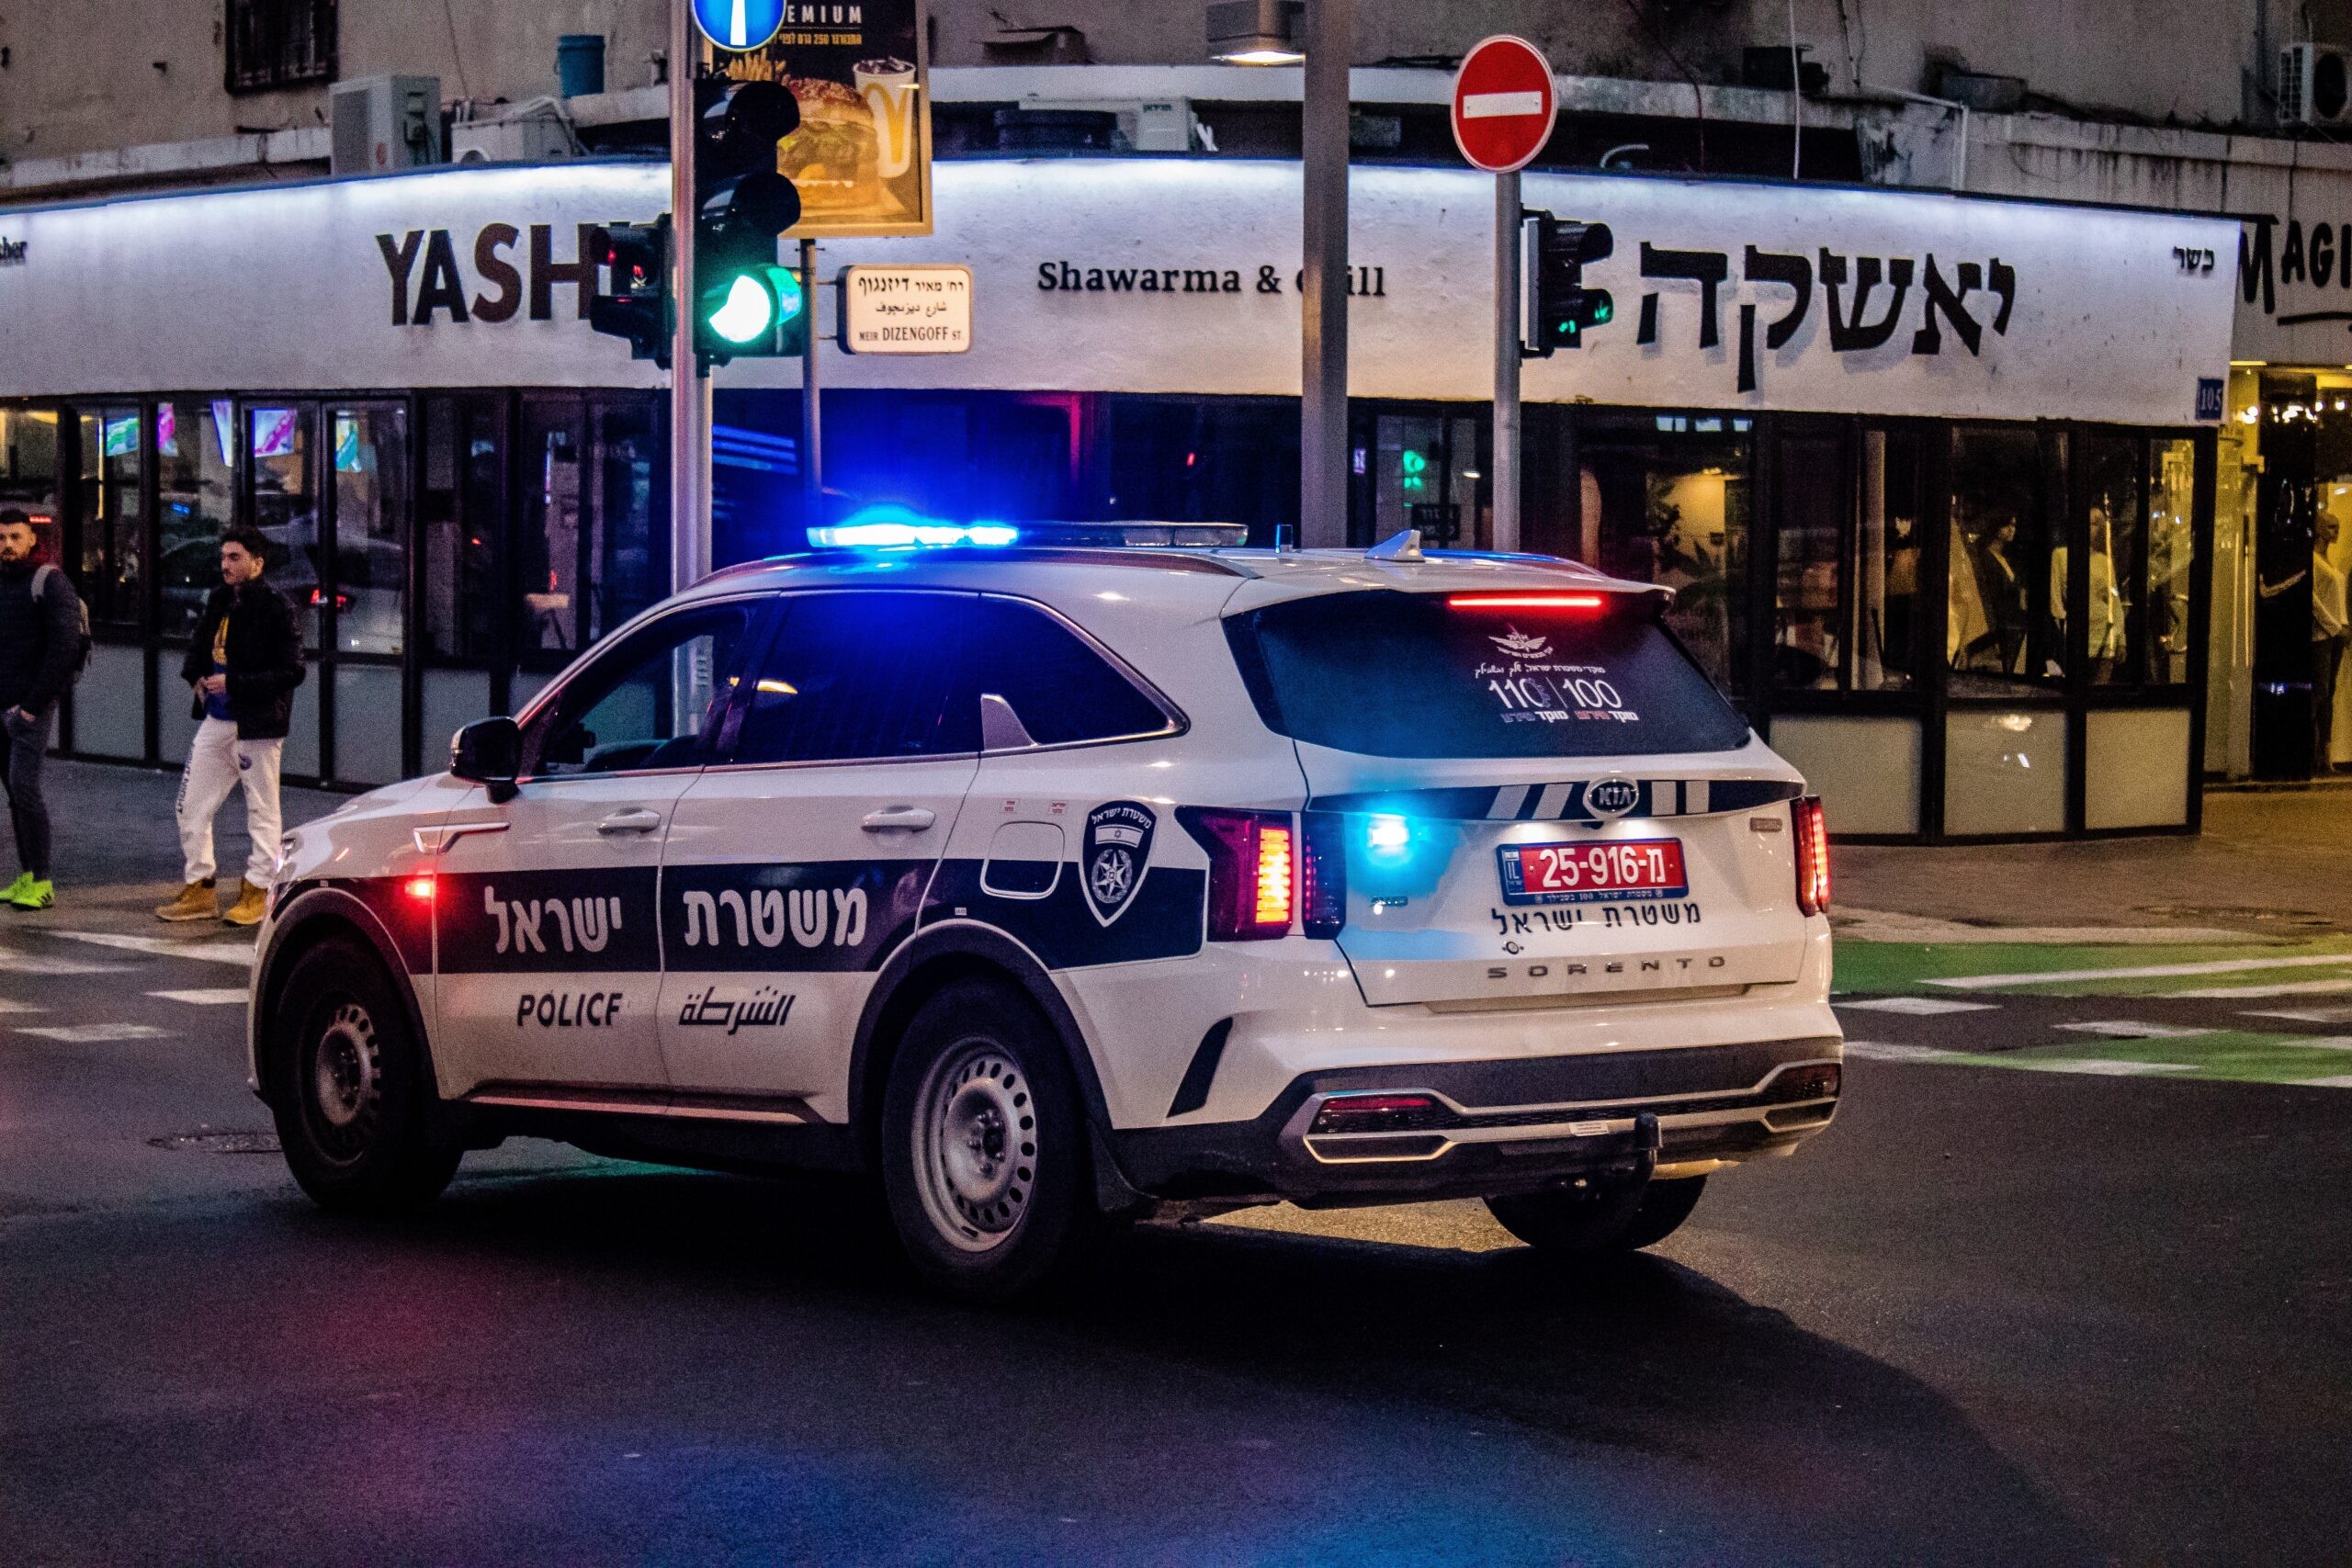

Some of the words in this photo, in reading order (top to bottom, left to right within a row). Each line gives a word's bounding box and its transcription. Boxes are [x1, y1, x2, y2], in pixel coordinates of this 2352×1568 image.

[787, 6, 863, 23] EMIUM
[0, 236, 28, 259] her
[2174, 246, 2215, 270] כשר
[375, 222, 602, 326] YASH
[1037, 262, 1242, 293] Shawarma
[1256, 265, 1283, 295] &
[1295, 265, 1385, 296] ill
[858, 277, 910, 297] דיזנגוף
[915, 281, 943, 292] מאיר
[926, 301, 947, 317] شارع
[1636, 242, 2016, 393] יאשקה
[859, 332, 879, 341] MEIR
[882, 327, 949, 341] DIZENGOFF
[2200, 387, 2222, 412] 105
[1488, 678, 1551, 708] 110
[1562, 678, 1623, 709] 100
[1534, 710, 1569, 723] מוקד
[1607, 710, 1640, 724] מוקד
[1599, 786, 1632, 806] KIA
[1091, 807, 1121, 826] ישראל
[1121, 807, 1153, 829] משטרת
[1578, 892, 1594, 900] 100
[1598, 890, 1623, 900] ישראל
[1626, 889, 1653, 899] משטרת
[483, 885, 622, 954] ישראל
[683, 887, 868, 948] משטרת
[1491, 908, 1584, 935] ישראל
[1602, 903, 1702, 928] משטרת
[1487, 956, 1725, 978] SORENTO
[678, 986, 797, 1035] الشرطة
